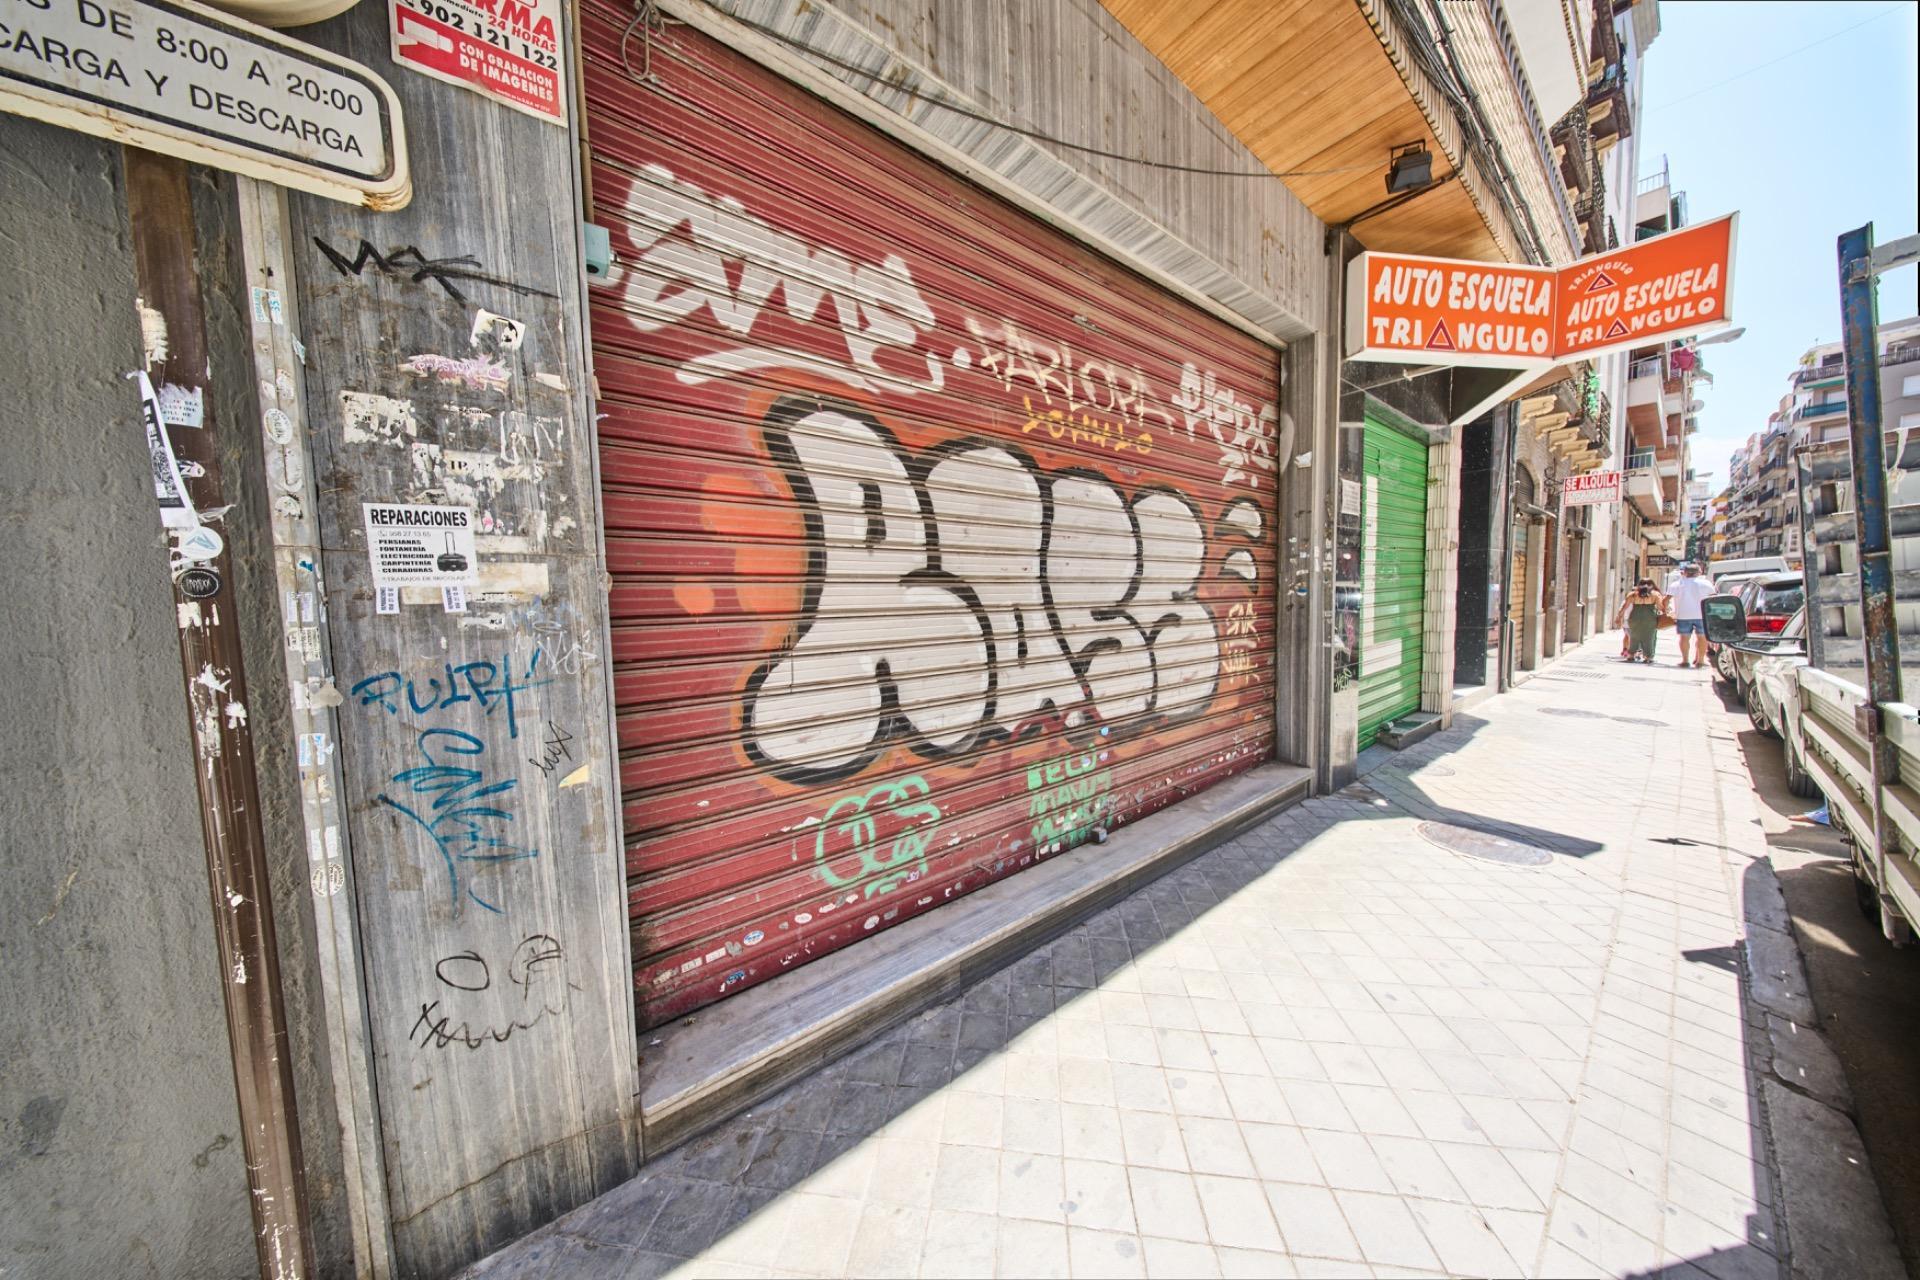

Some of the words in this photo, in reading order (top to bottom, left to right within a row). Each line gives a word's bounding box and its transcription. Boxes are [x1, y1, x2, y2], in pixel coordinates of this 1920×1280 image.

[78, 0, 134, 40] DE
[157, 27, 228, 70] 8:00
[247, 60, 270, 86] A
[286, 73, 363, 116] 20:00
[420, 0, 464, 31] 902
[473, 22, 510, 50] 121
[522, 44, 558, 71] 122
[488, 15, 506, 31] 24
[511, 26, 557, 53] HORAS
[459, 41, 484, 61] CON
[487, 53, 553, 88] GRABACION
[459, 53, 479, 72] DE
[483, 65, 554, 101] IMAGENES
[144, 69, 168, 96] Y
[189, 84, 363, 157] DESCARGA
[1374, 265, 1443, 308] AUTO
[1448, 271, 1551, 317] ESCUELA
[1566, 290, 1620, 327] AUTO
[1623, 262, 1719, 313] ESCUELA
[1565, 478, 1578, 491] SE
[1579, 473, 1618, 490] ALQUILA
